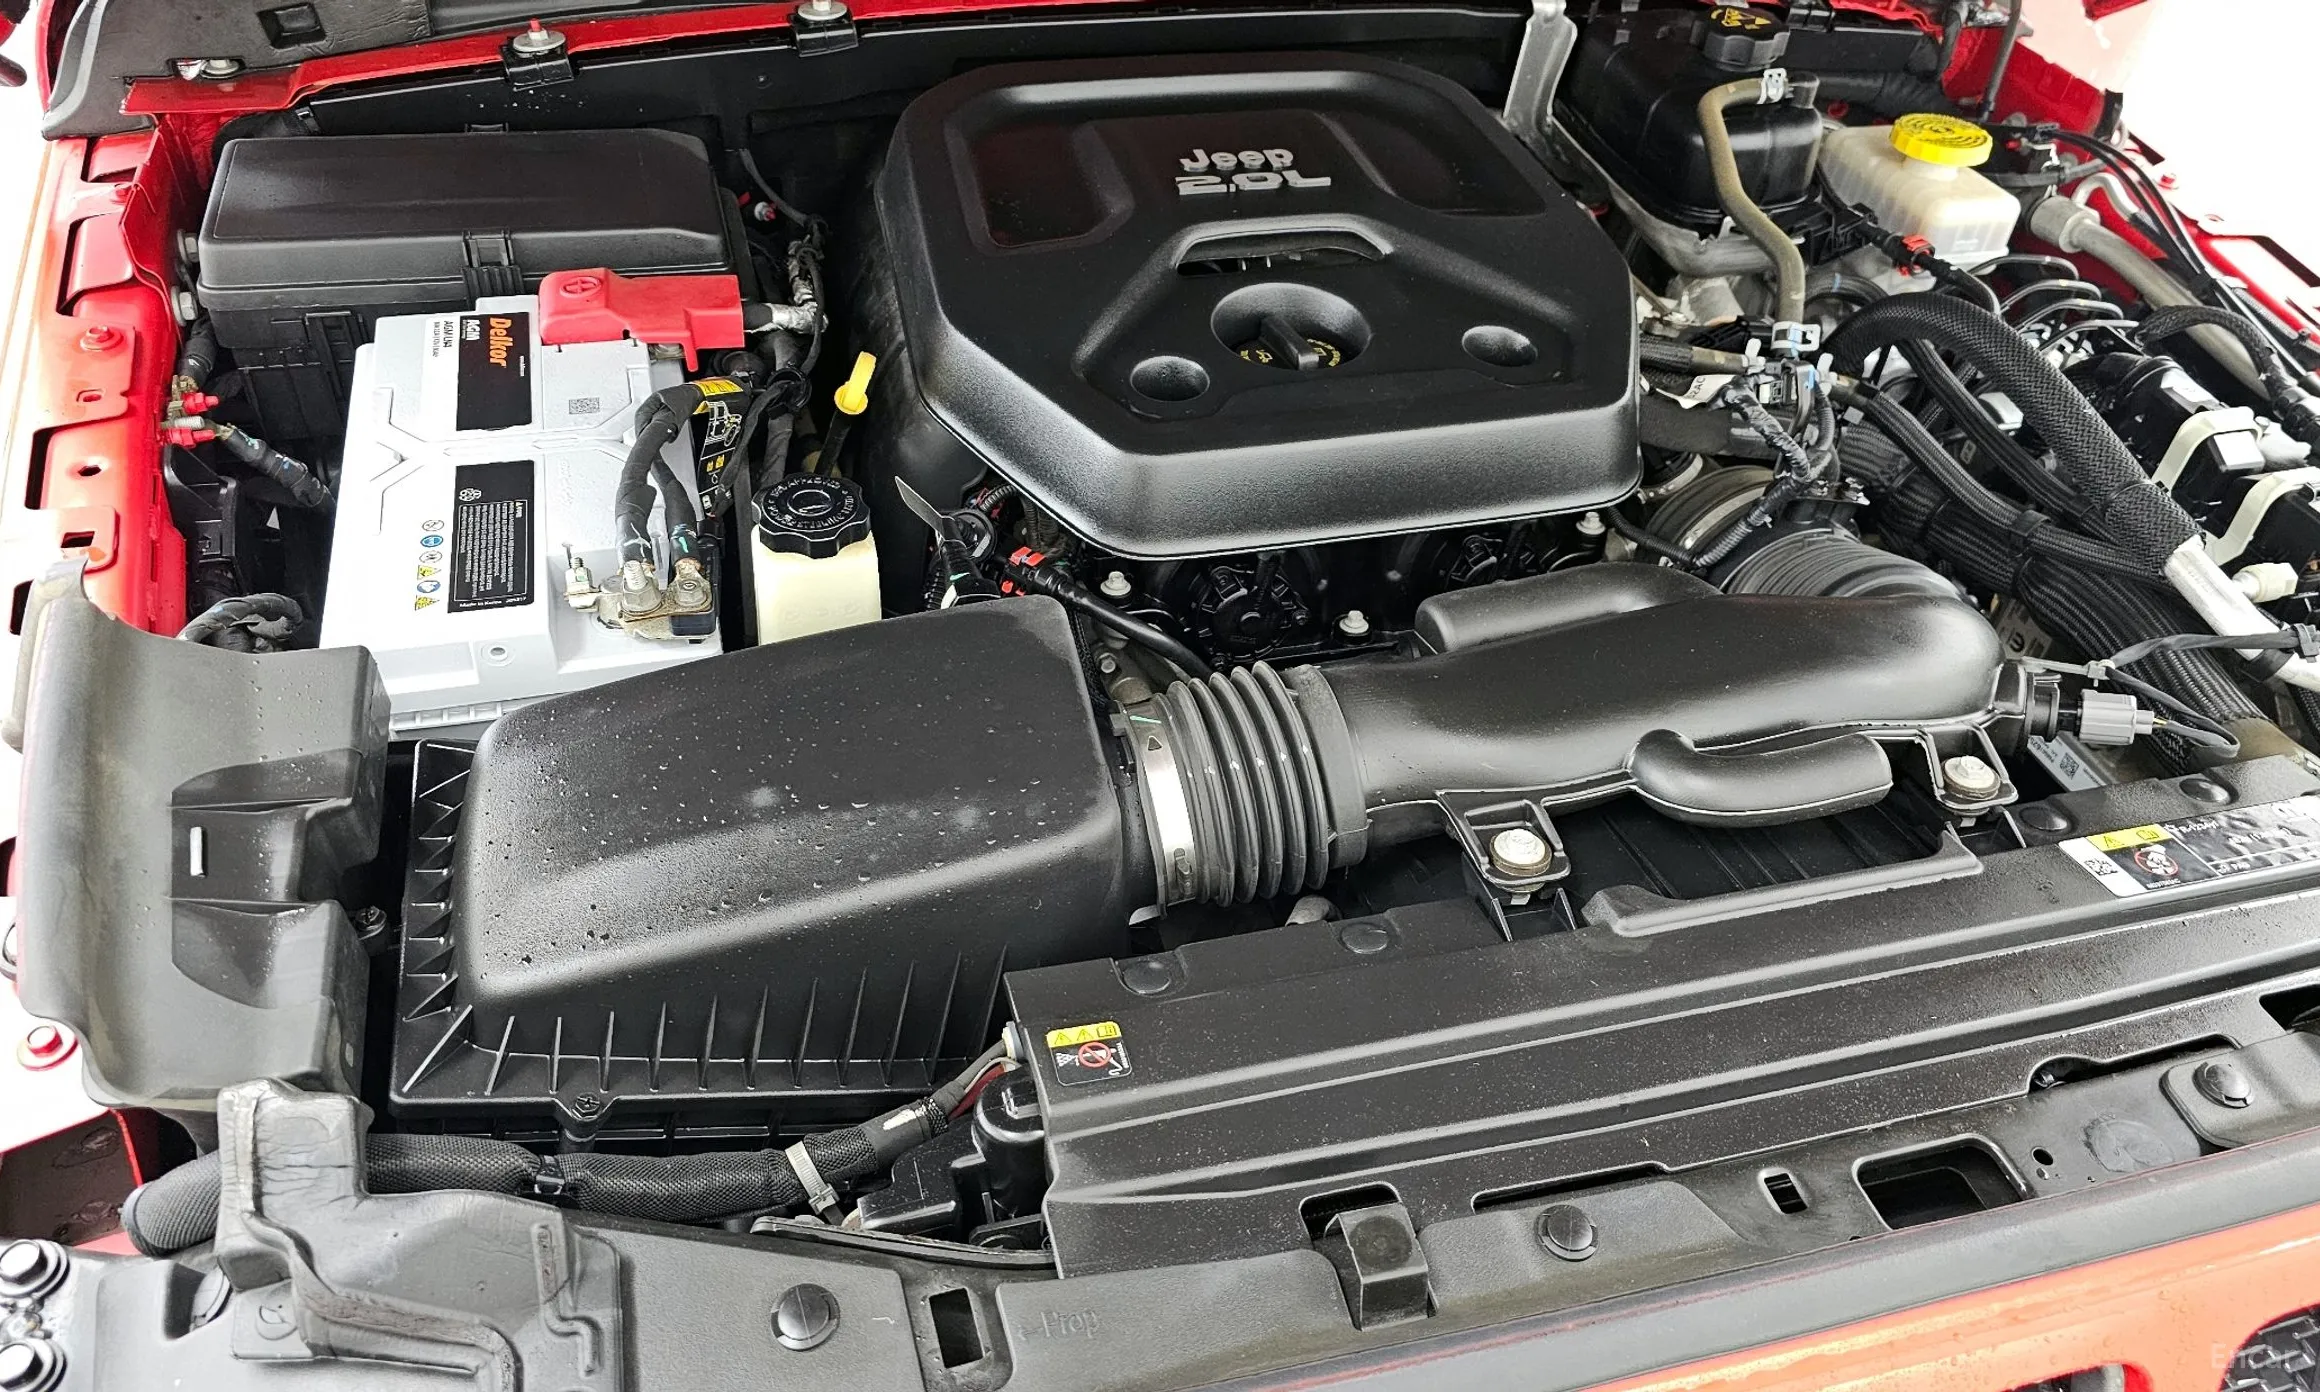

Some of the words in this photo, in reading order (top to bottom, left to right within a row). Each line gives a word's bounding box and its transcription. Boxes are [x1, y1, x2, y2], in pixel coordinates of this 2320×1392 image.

[1179, 149, 1294, 172] Jeep
[1175, 170, 1332, 196] 2.0L
[443, 320, 454, 337] AGM
[466, 318, 480, 341] AGM
[489, 316, 514, 368] Delkor
